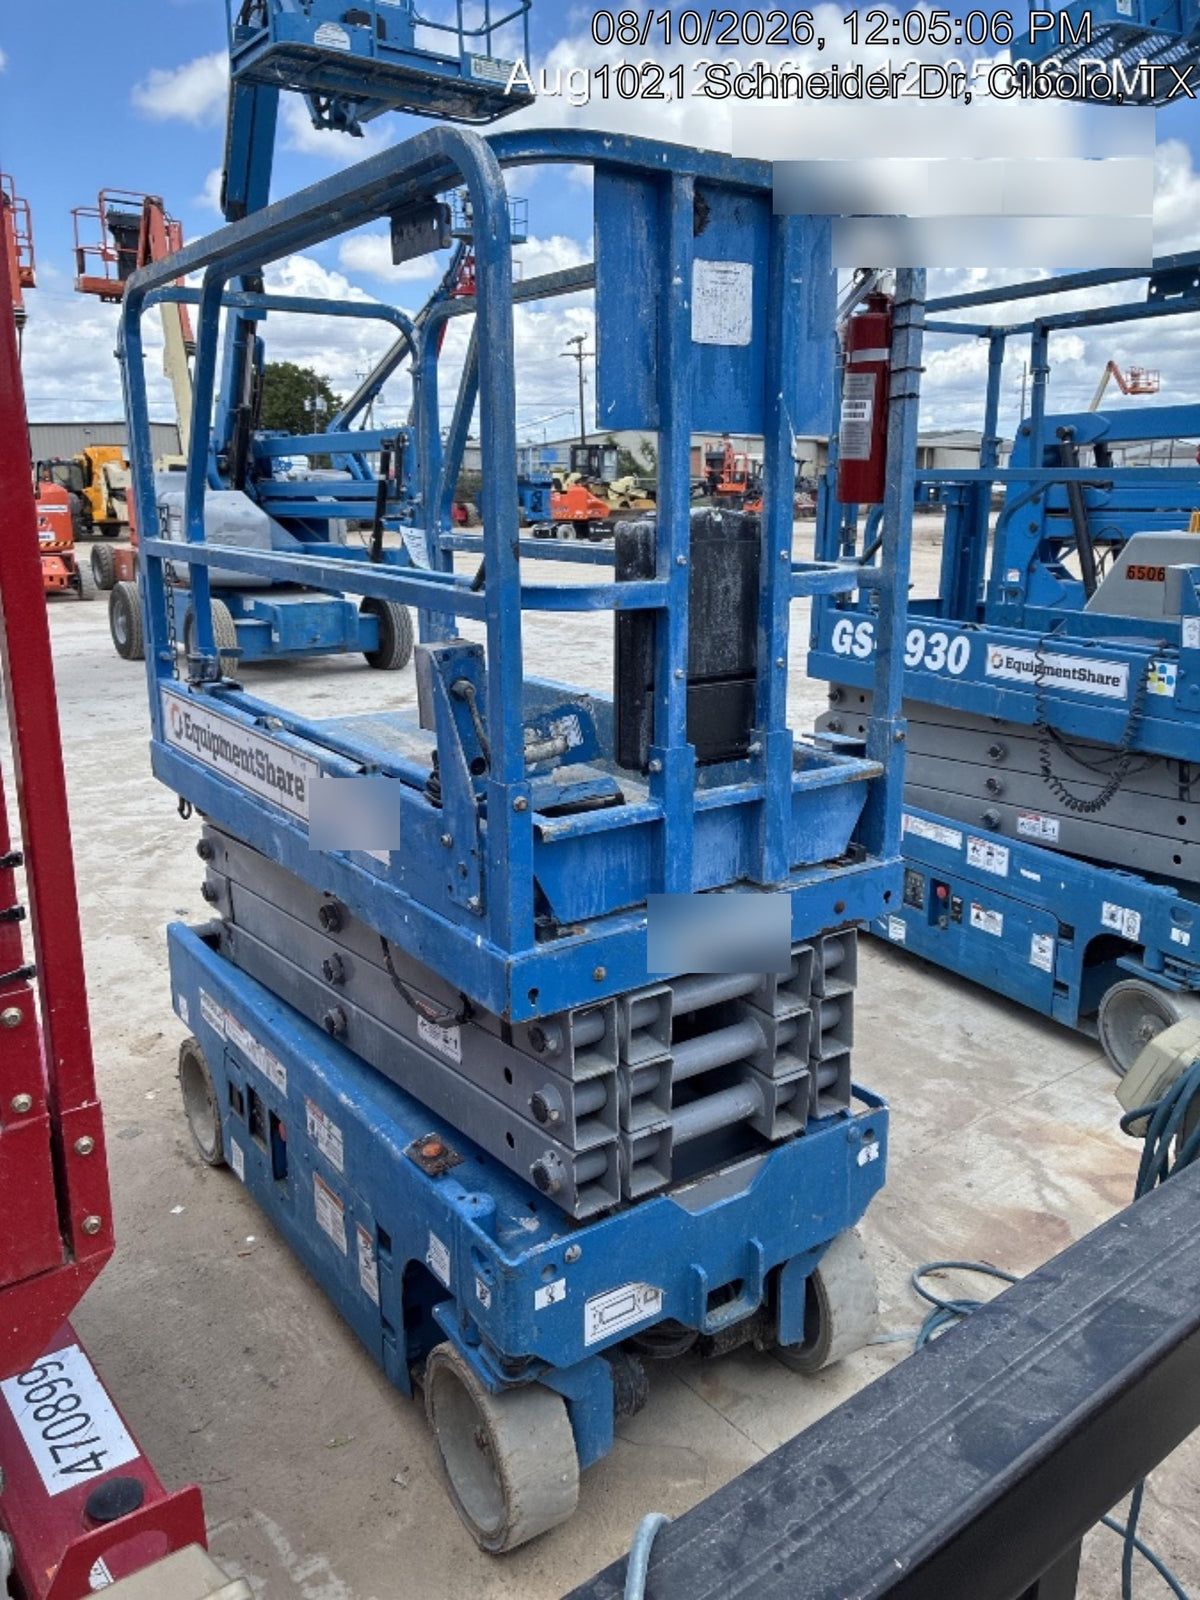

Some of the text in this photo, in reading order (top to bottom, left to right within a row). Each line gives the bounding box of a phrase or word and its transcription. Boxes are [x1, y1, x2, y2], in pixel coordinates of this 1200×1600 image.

[1126, 564, 1166, 582] 6506
[1005, 656, 1121, 687] EquipmentShare
[183, 711, 305, 803] EquipmentShare
[16, 1361, 109, 1475] 470899
